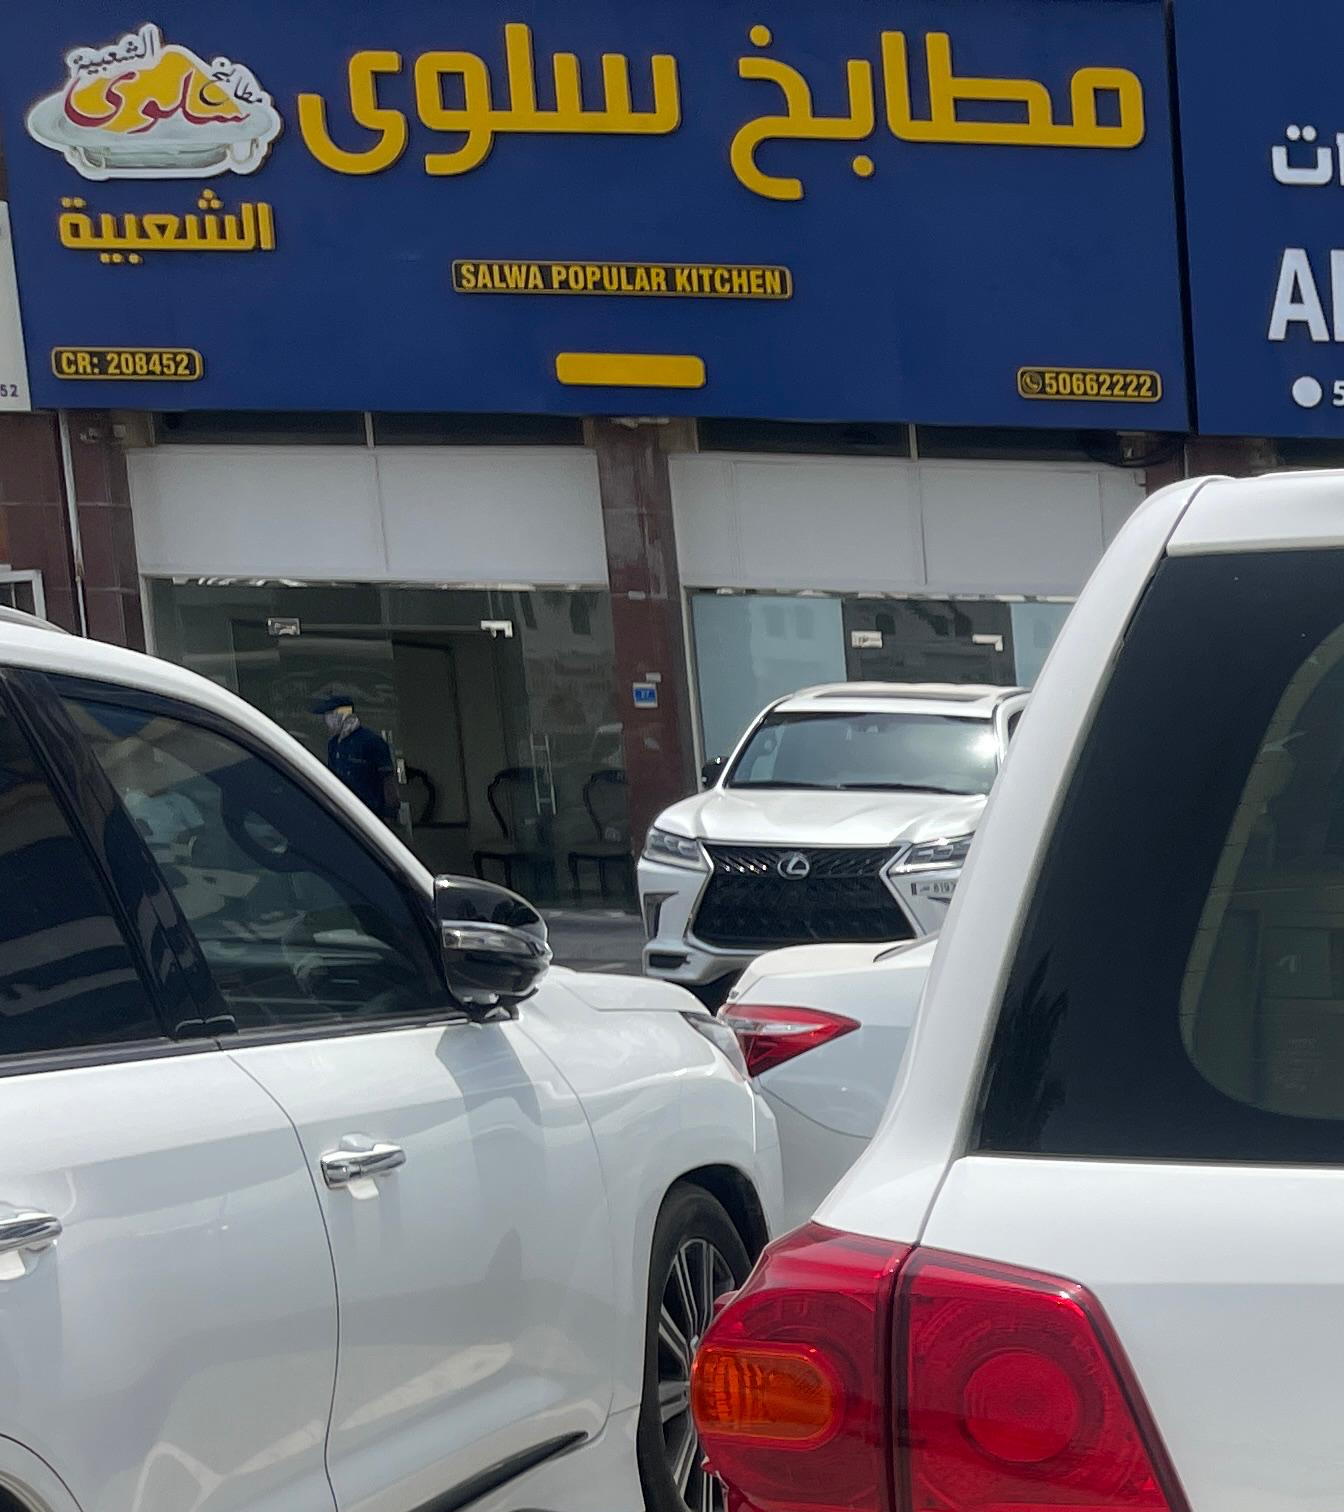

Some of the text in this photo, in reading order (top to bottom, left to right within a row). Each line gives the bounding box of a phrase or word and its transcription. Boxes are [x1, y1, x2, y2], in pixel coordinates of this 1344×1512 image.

[64, 70, 250, 134] سلوى
[298, 23, 1145, 200] مطابخ سلوى
[60, 188, 274, 264] الشعبية
[461, 263, 781, 294] SALWA POPULAR KITCHEN
[60, 352, 190, 375] CR: 208452
[1045, 373, 1153, 397] 50662222
